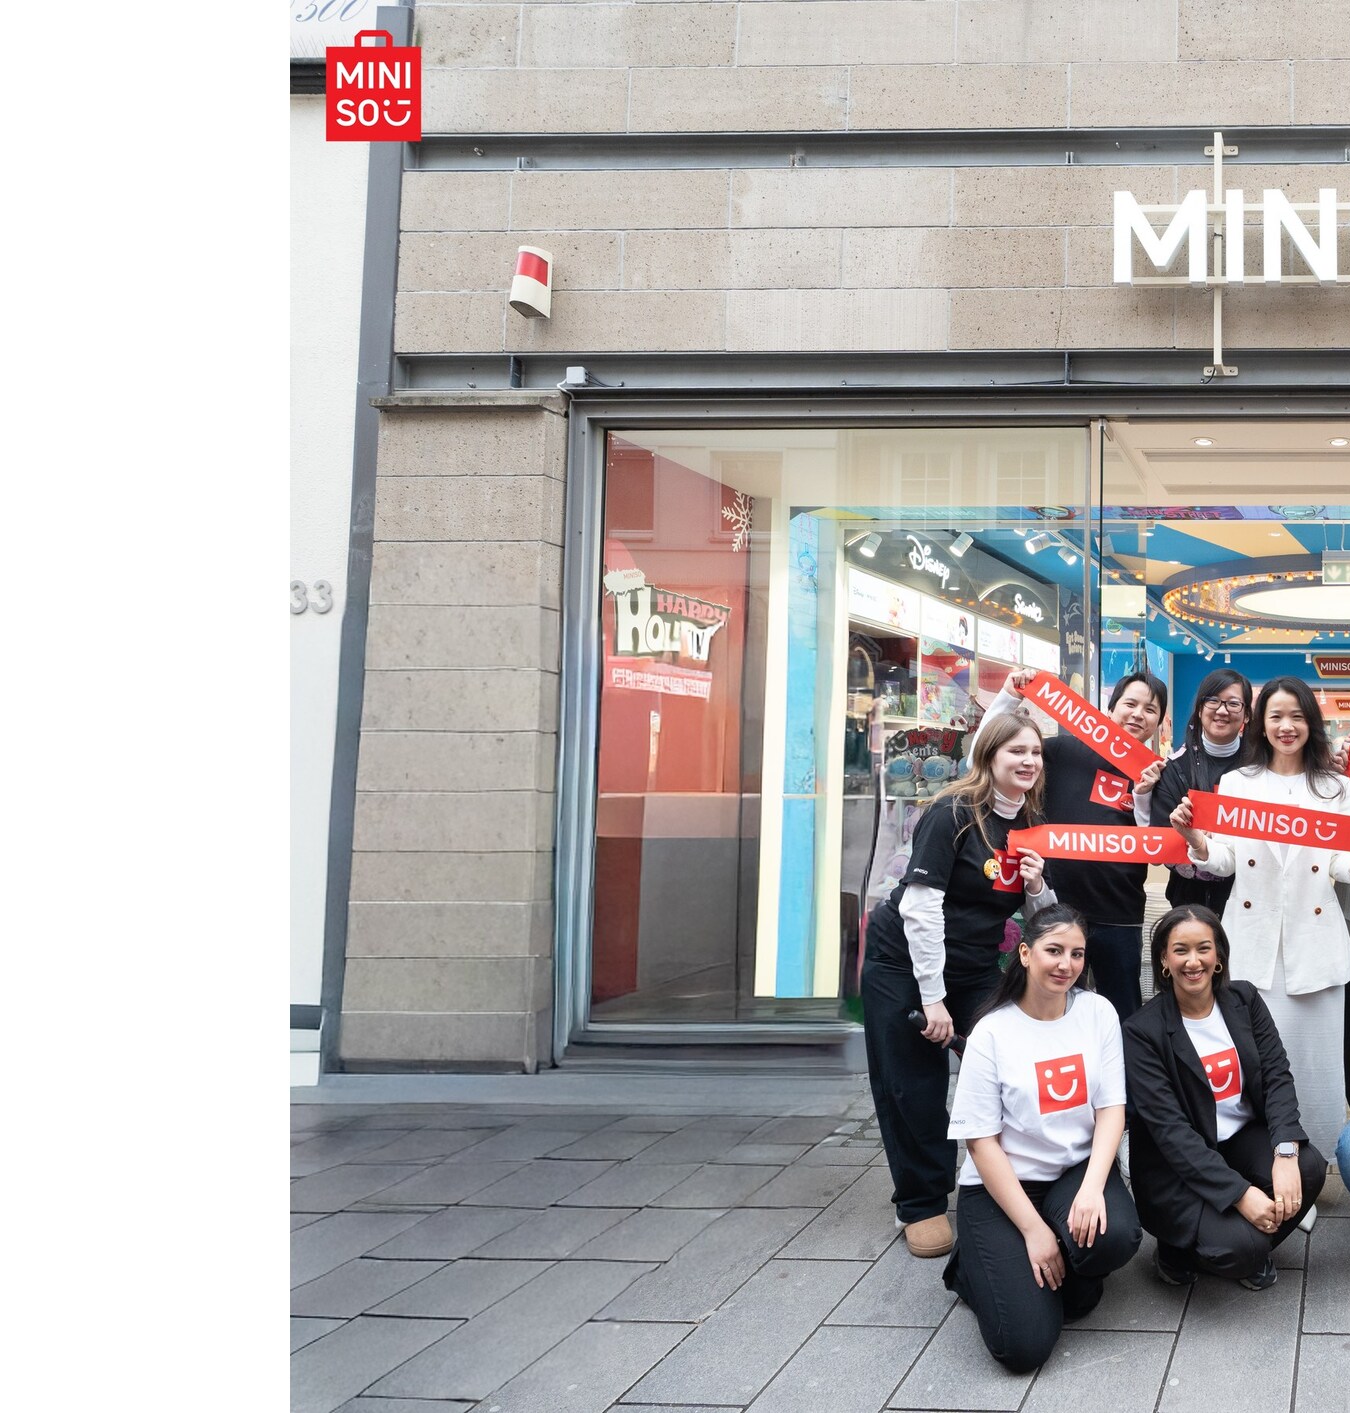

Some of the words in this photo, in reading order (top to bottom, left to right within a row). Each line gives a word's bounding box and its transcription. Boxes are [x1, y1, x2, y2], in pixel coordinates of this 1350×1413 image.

[1036, 681, 1110, 743] MINISO
[1216, 804, 1308, 838] MINISO
[1048, 831, 1137, 854] MINISO
